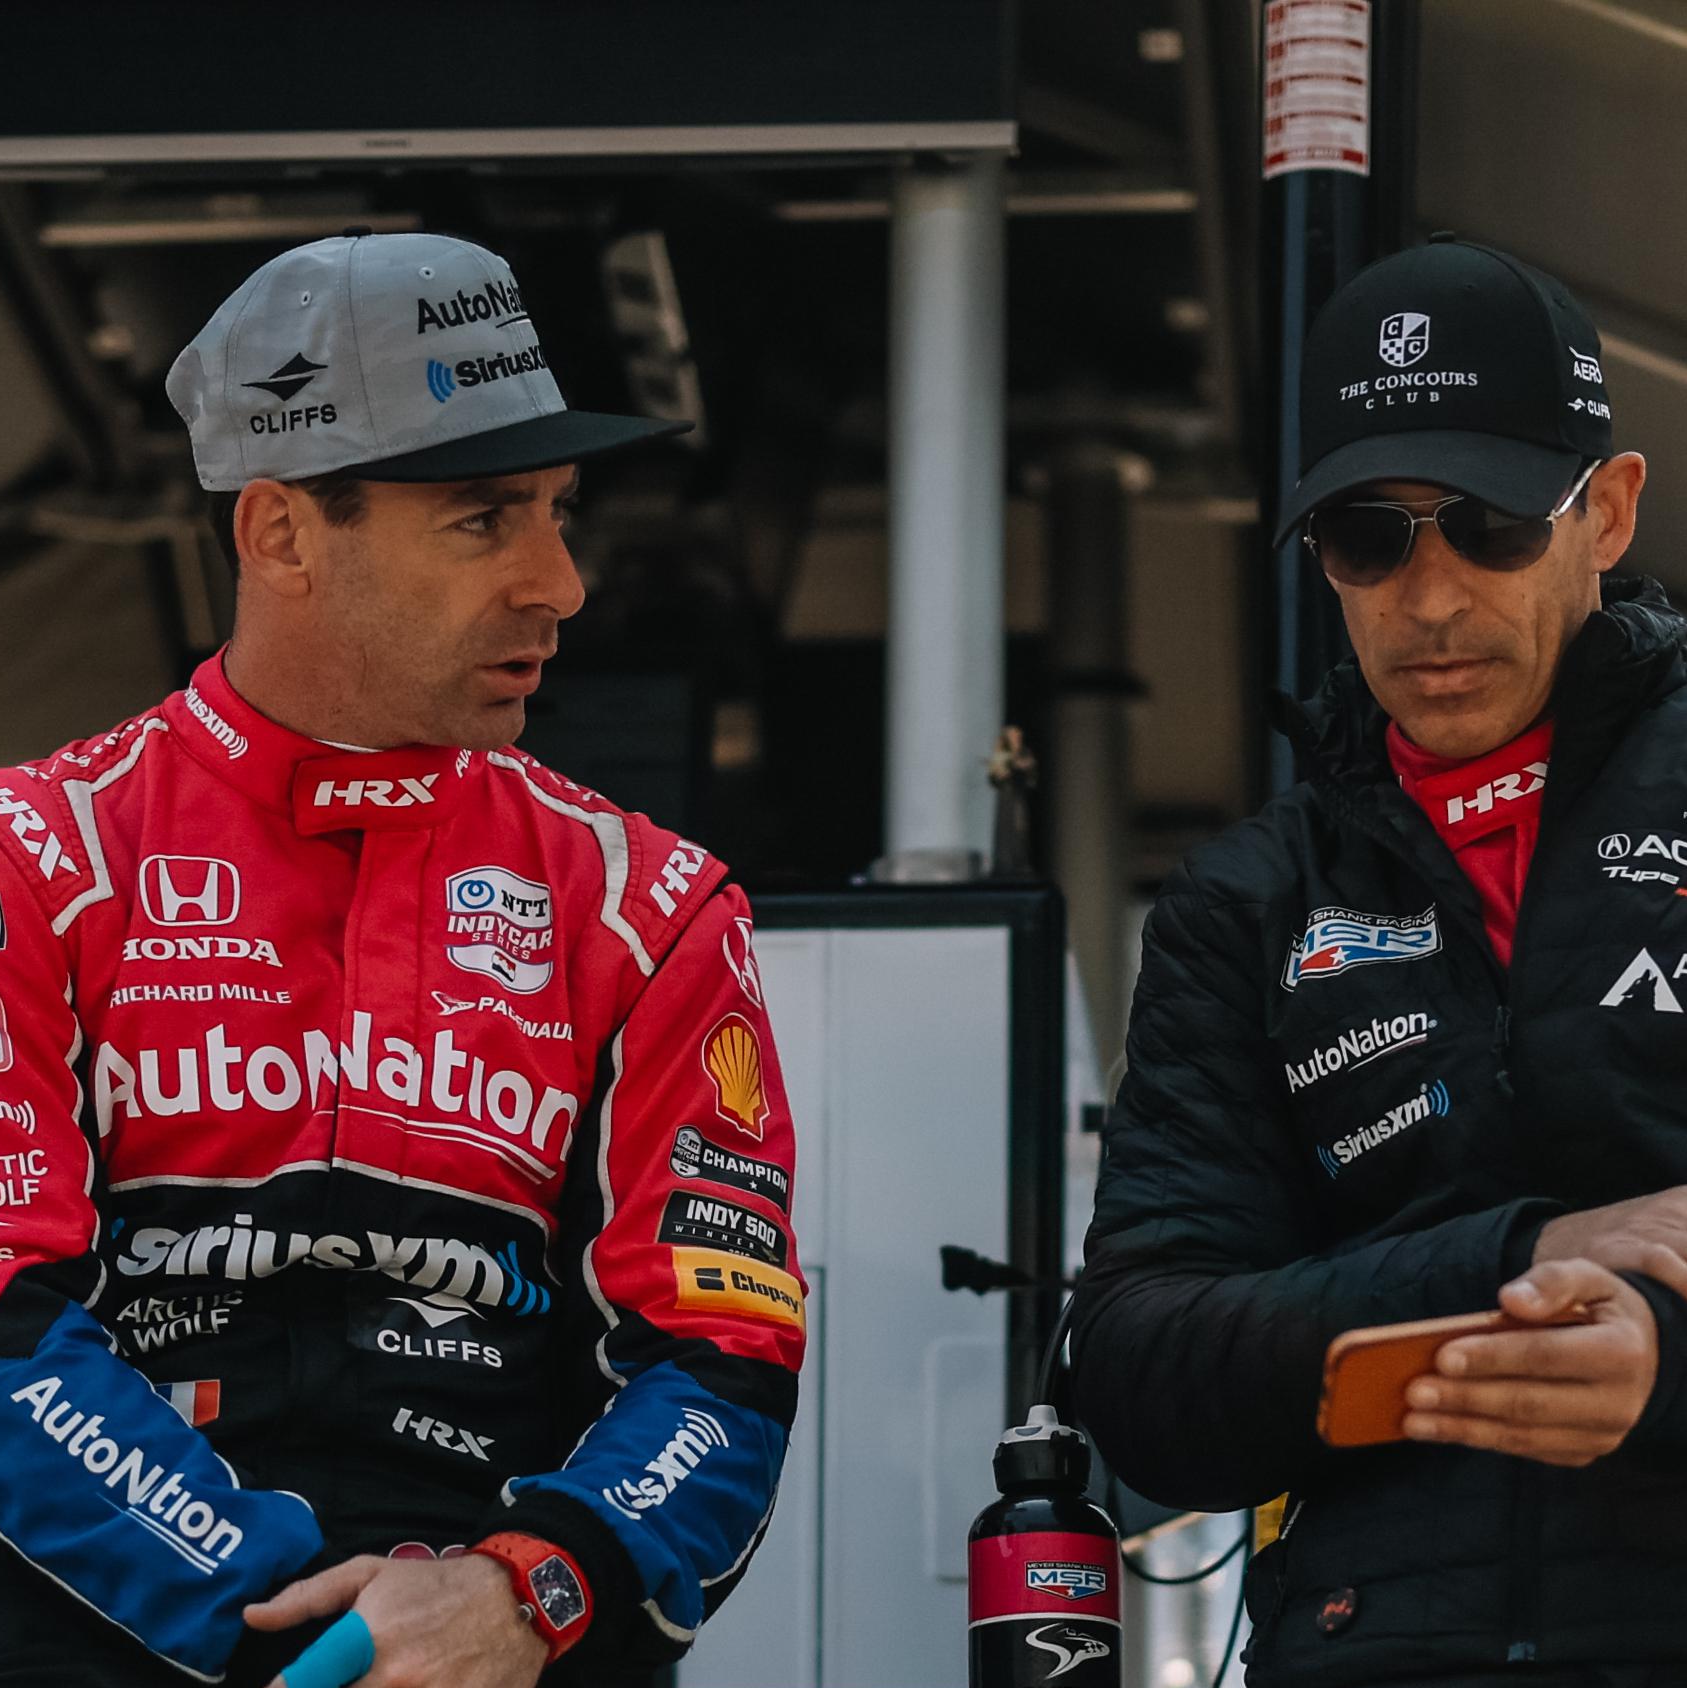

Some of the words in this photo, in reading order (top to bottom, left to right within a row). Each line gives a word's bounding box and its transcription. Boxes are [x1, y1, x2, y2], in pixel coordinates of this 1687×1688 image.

[1339, 381, 1369, 401] THE
[1374, 372, 1478, 391] CONCOURS
[1573, 361, 1603, 385] AERO
[1365, 391, 1440, 410] CLUB
[250, 403, 338, 435] CLIFFS
[313, 773, 440, 807] HRX
[501, 889, 548, 918] NTT
[1313, 910, 1371, 925] SHANK
[1376, 911, 1435, 929] RACING
[447, 914, 553, 951] INDYCAR
[471, 931, 531, 961] SERIES
[109, 984, 215, 1008] RICHARD
[218, 983, 293, 1004] MILLE
[477, 996, 573, 1041] PANAU
[1284, 1012, 1428, 1094] AutoNation
[95, 1010, 579, 1162] AutoNation
[703, 1148, 788, 1194] CHAMPION
[675, 1224, 755, 1249] WINNER
[686, 1199, 743, 1230] INDY
[745, 1215, 777, 1249] 500
[730, 1270, 799, 1314] Clopay
[132, 1308, 230, 1353] WOLF
[376, 1328, 503, 1369] CLIFFS
[391, 1407, 496, 1462] HRX
[10, 1376, 244, 1561] AutoNtion
[1030, 1570, 1105, 1588] MSR
